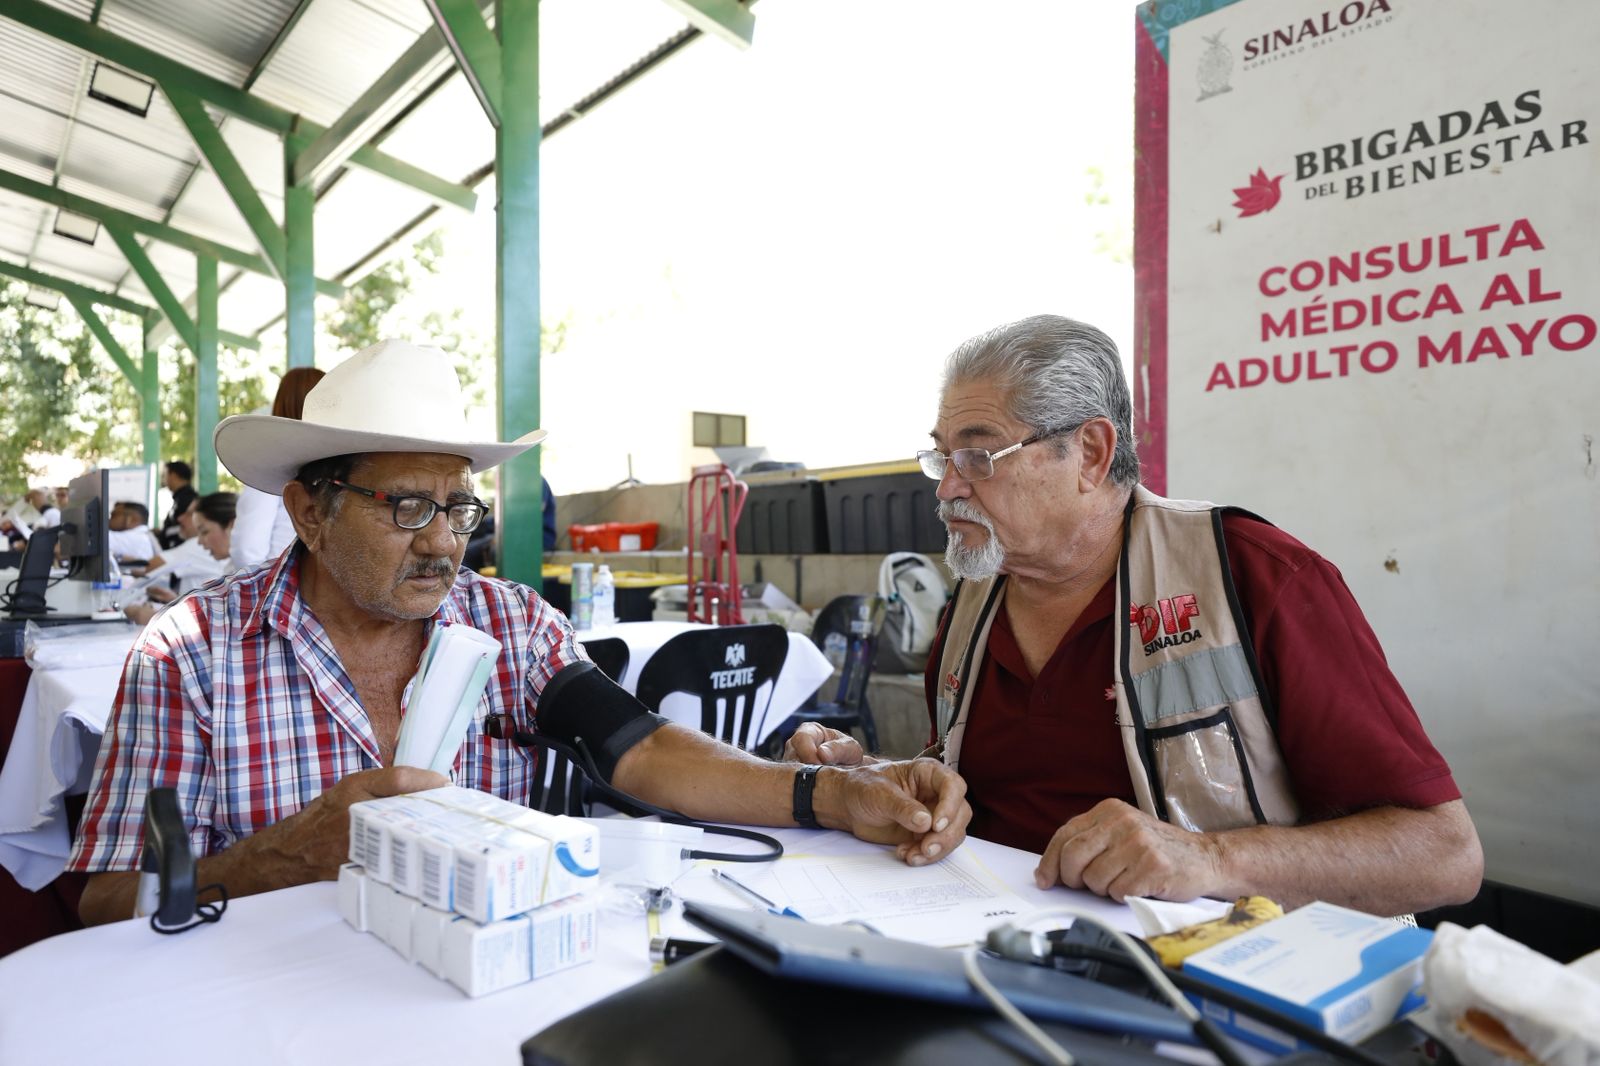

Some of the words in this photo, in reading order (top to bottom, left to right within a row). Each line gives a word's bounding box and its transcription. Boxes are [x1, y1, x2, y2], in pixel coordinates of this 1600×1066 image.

[1243, 0, 1392, 62] SINALOA
[1312, 36, 1334, 49] DEL
[1341, 15, 1393, 39] ESTADO
[1295, 89, 1542, 182] BRIGADAS
[1305, 182, 1339, 200] DEL
[1345, 119, 1589, 200] BIENESTAR
[1258, 218, 1546, 298] CONSULTA
[1261, 283, 1464, 342] MÉDICA
[1479, 267, 1562, 311] AL
[1205, 340, 1399, 392] ADULTO
[1138, 593, 1200, 645] DIF
[1144, 629, 1202, 657] SINALOA
[709, 666, 757, 690] TECATE
